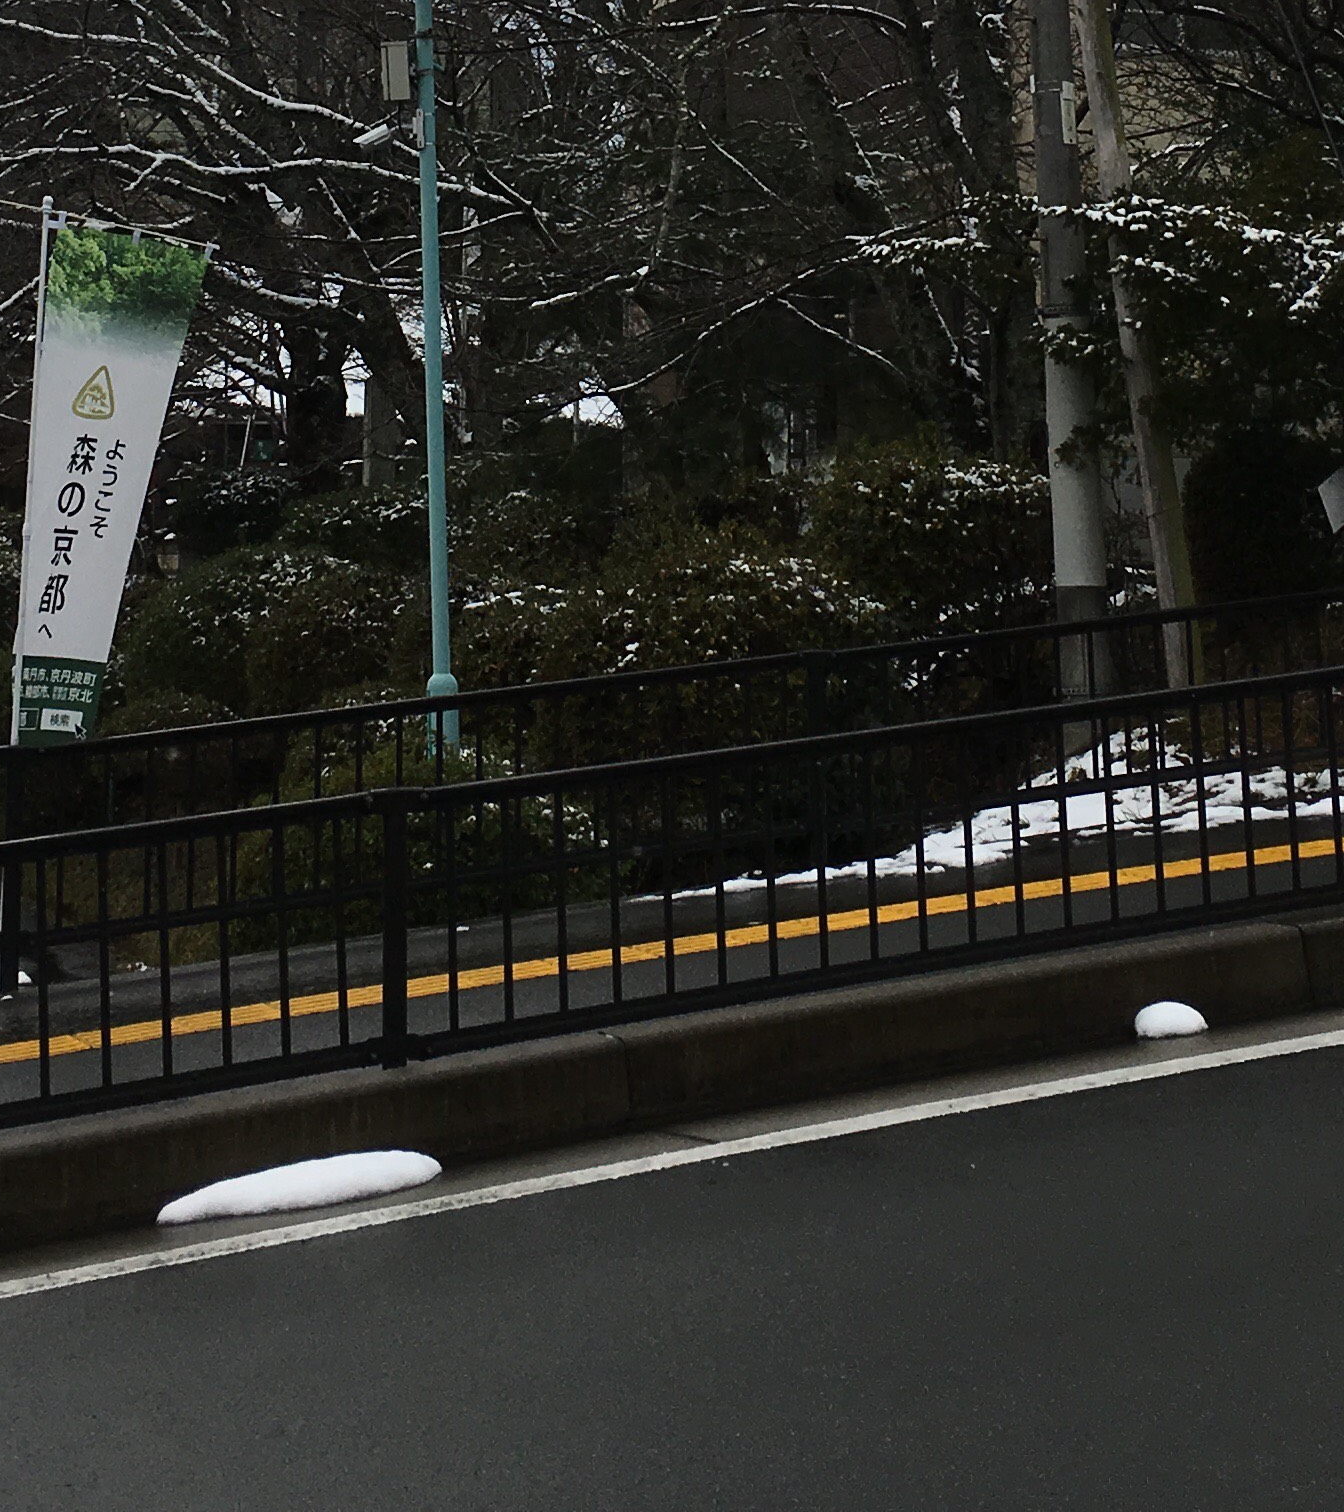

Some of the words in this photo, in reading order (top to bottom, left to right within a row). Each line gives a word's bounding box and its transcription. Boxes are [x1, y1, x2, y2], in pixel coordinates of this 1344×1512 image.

[38, 433, 98, 639] 森の京都へ
[89, 439, 127, 539] ようこそ
